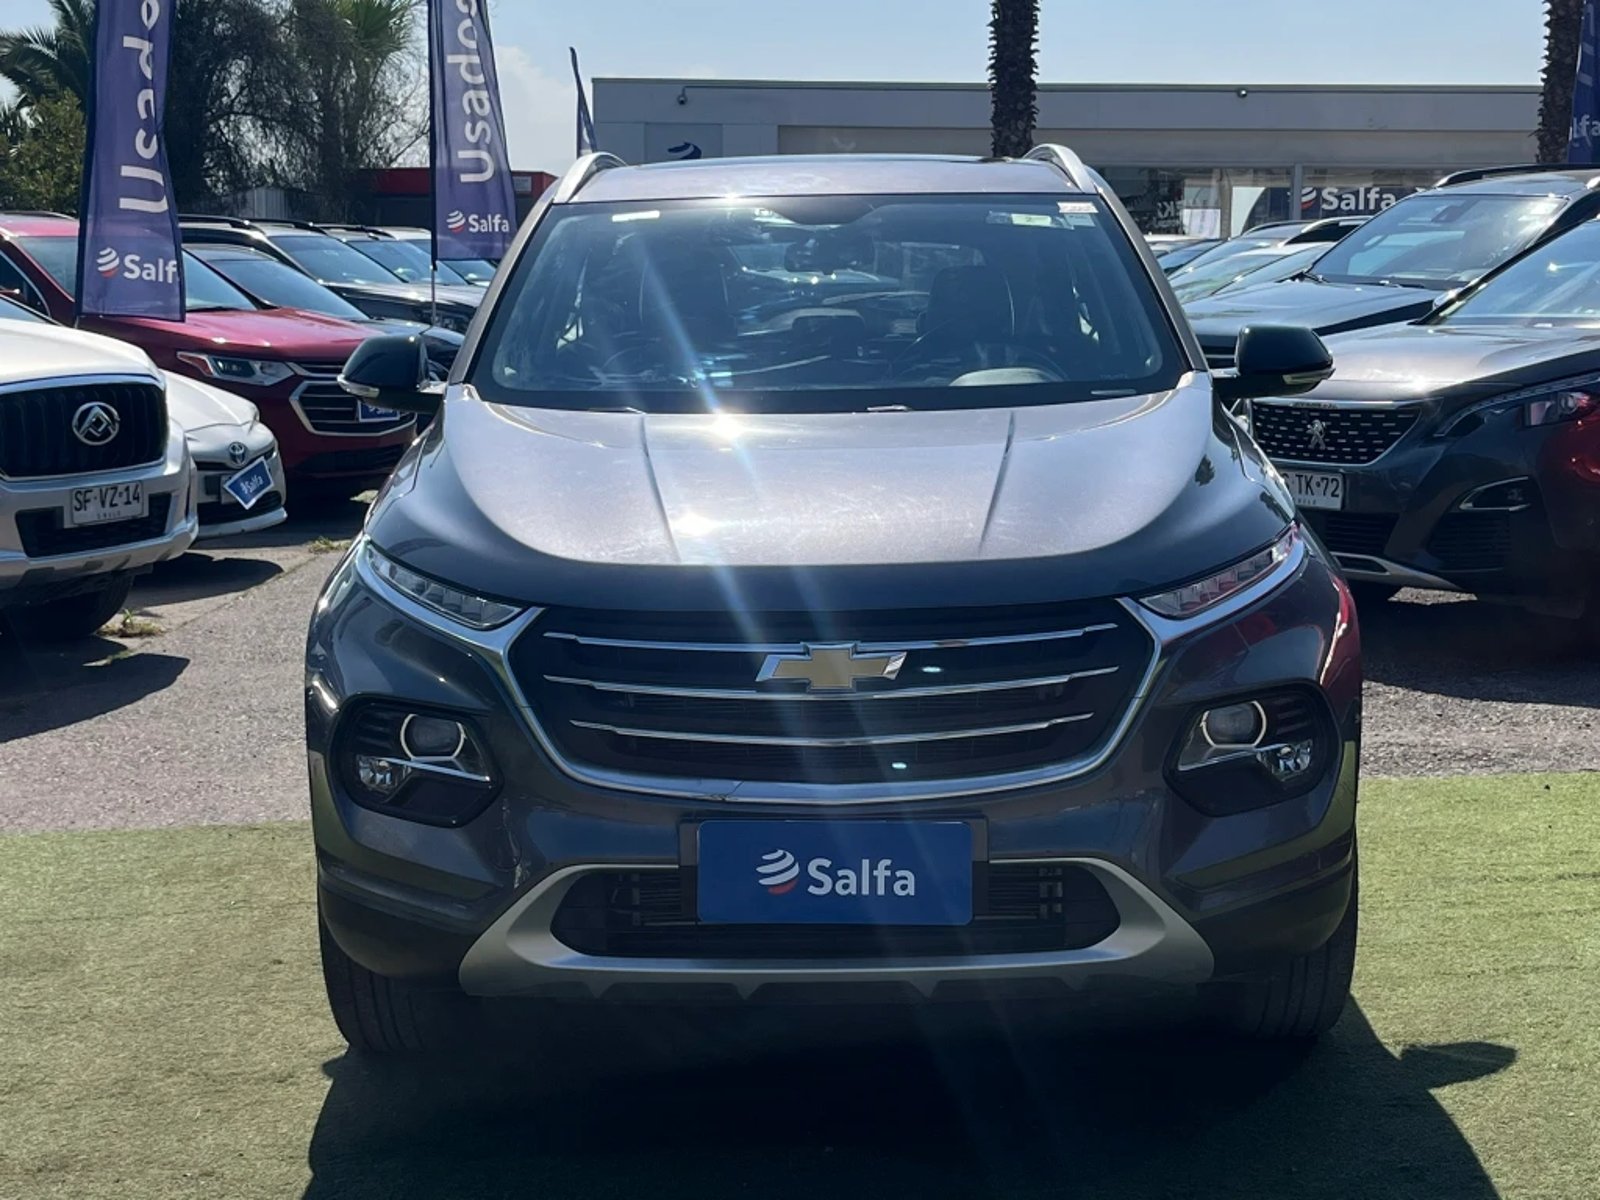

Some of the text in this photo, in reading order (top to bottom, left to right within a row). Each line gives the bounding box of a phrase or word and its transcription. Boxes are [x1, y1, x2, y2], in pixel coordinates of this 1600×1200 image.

[1573, 114, 1600, 138] lfa
[1321, 187, 1397, 210] Salfa
[468, 213, 510, 233] Salfa
[123, 254, 177, 284] Salf
[807, 857, 916, 896] Salfa
